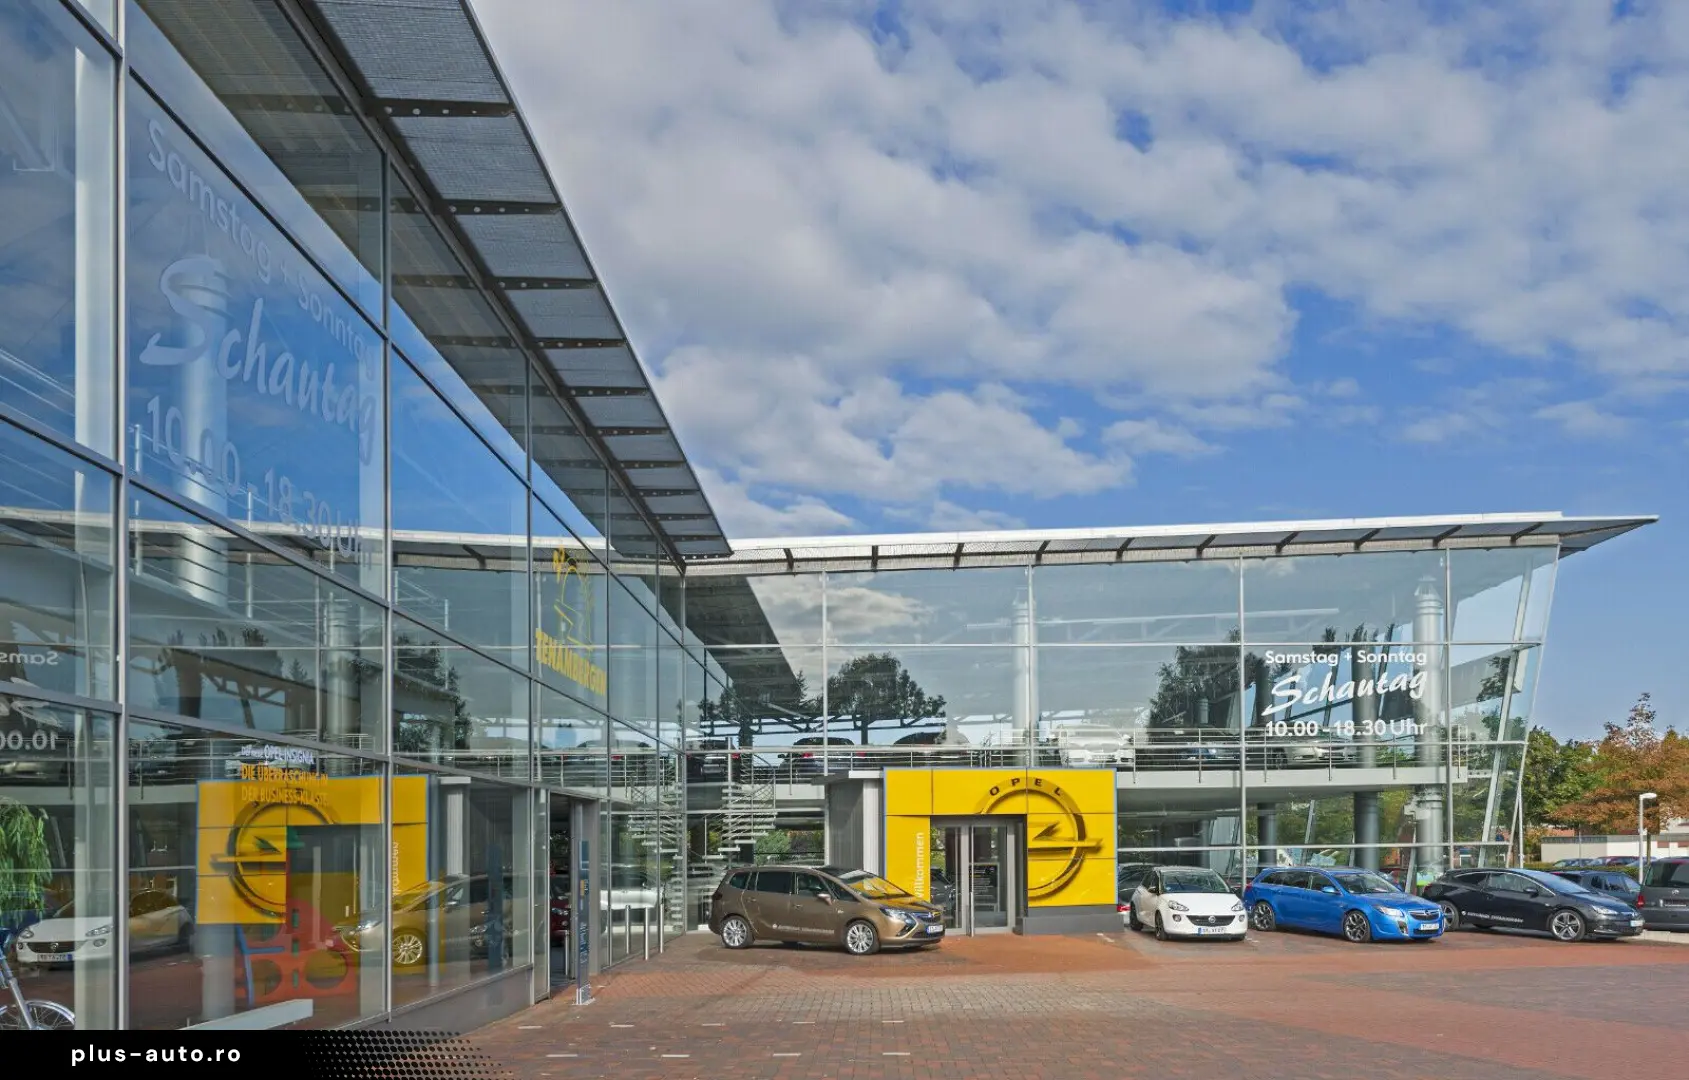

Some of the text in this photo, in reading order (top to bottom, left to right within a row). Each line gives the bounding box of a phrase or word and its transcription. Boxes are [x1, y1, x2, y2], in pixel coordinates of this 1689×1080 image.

[148, 119, 272, 284] Samstag
[139, 254, 379, 467] Schautag
[147, 395, 240, 499] 10.00
[264, 466, 332, 549] 18.30
[1265, 650, 1339, 666] Samstag
[1357, 650, 1427, 666] Sonntag
[1261, 670, 1428, 716] Schautag
[1266, 720, 1319, 737] 10.00
[1335, 720, 1386, 736] 18.30
[1391, 720, 1428, 736] Uhr
[989, 777, 1064, 797] OPEL
